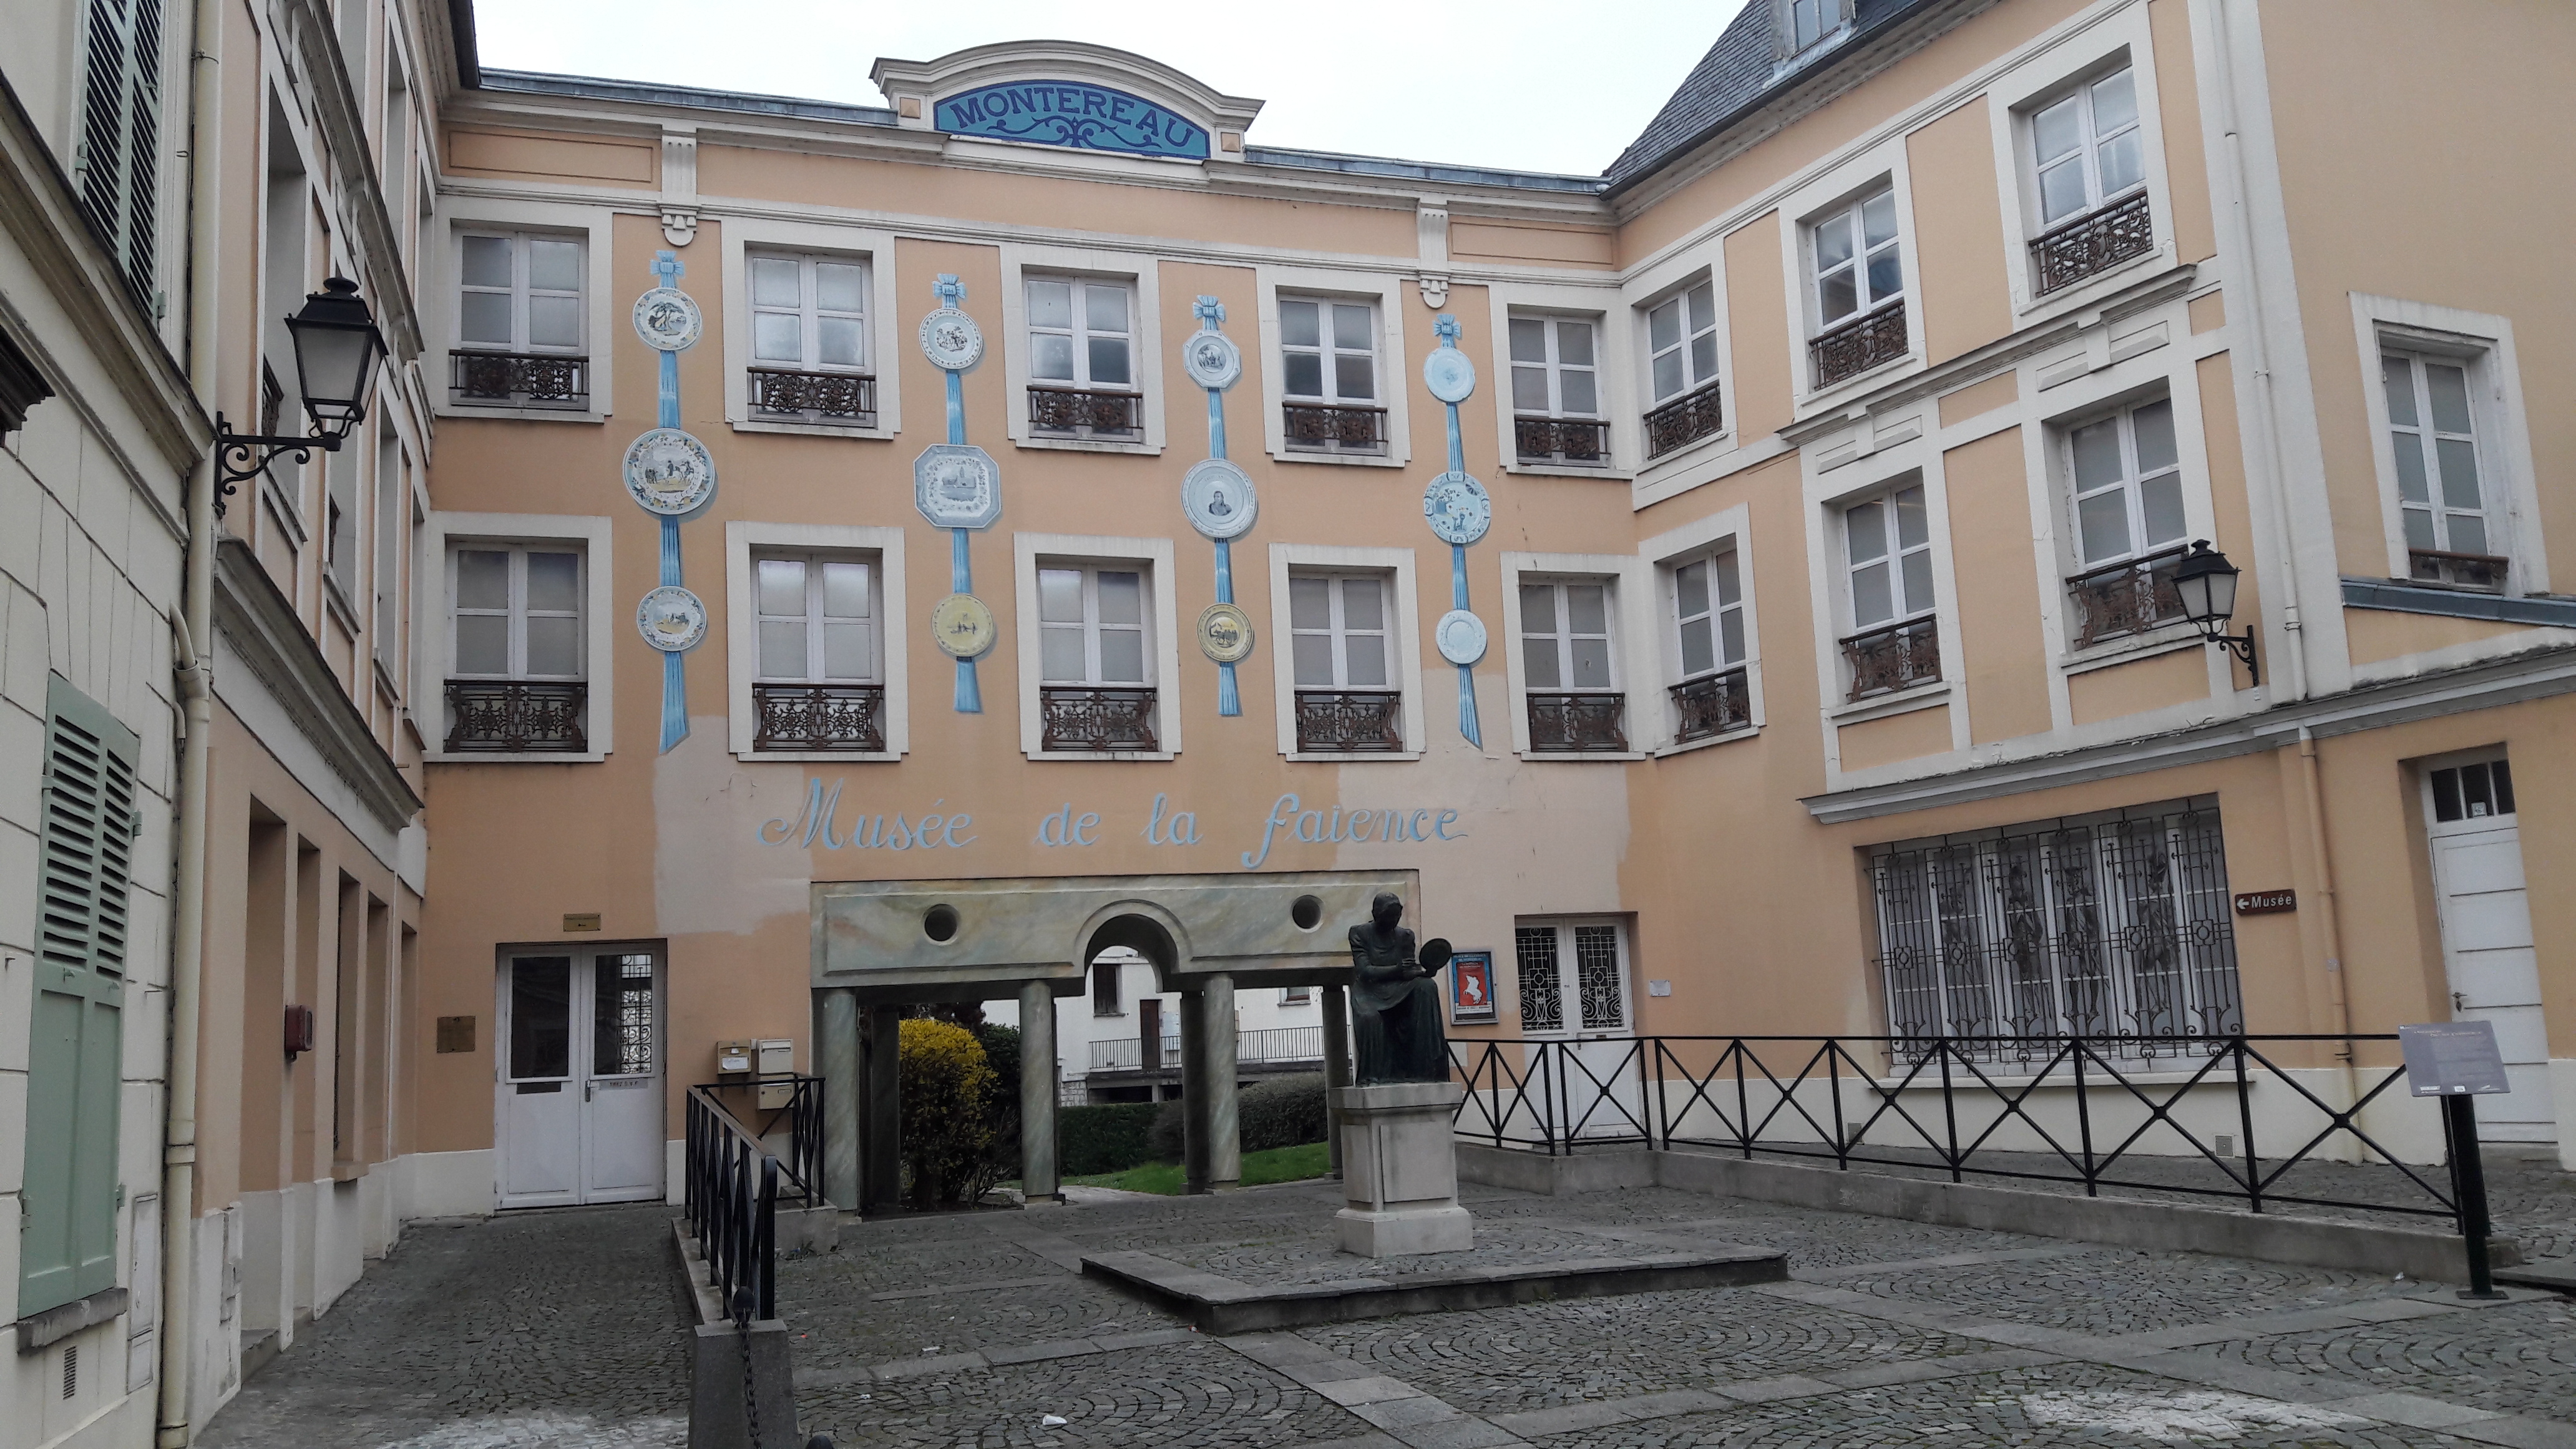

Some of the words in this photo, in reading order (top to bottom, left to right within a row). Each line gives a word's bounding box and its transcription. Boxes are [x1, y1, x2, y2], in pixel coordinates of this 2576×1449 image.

[949, 87, 1194, 147] MONTEREAU
[756, 778, 978, 850] Musée
[1033, 802, 1100, 847] de
[1140, 793, 1204, 846] la
[2252, 894, 2292, 909] Musée
